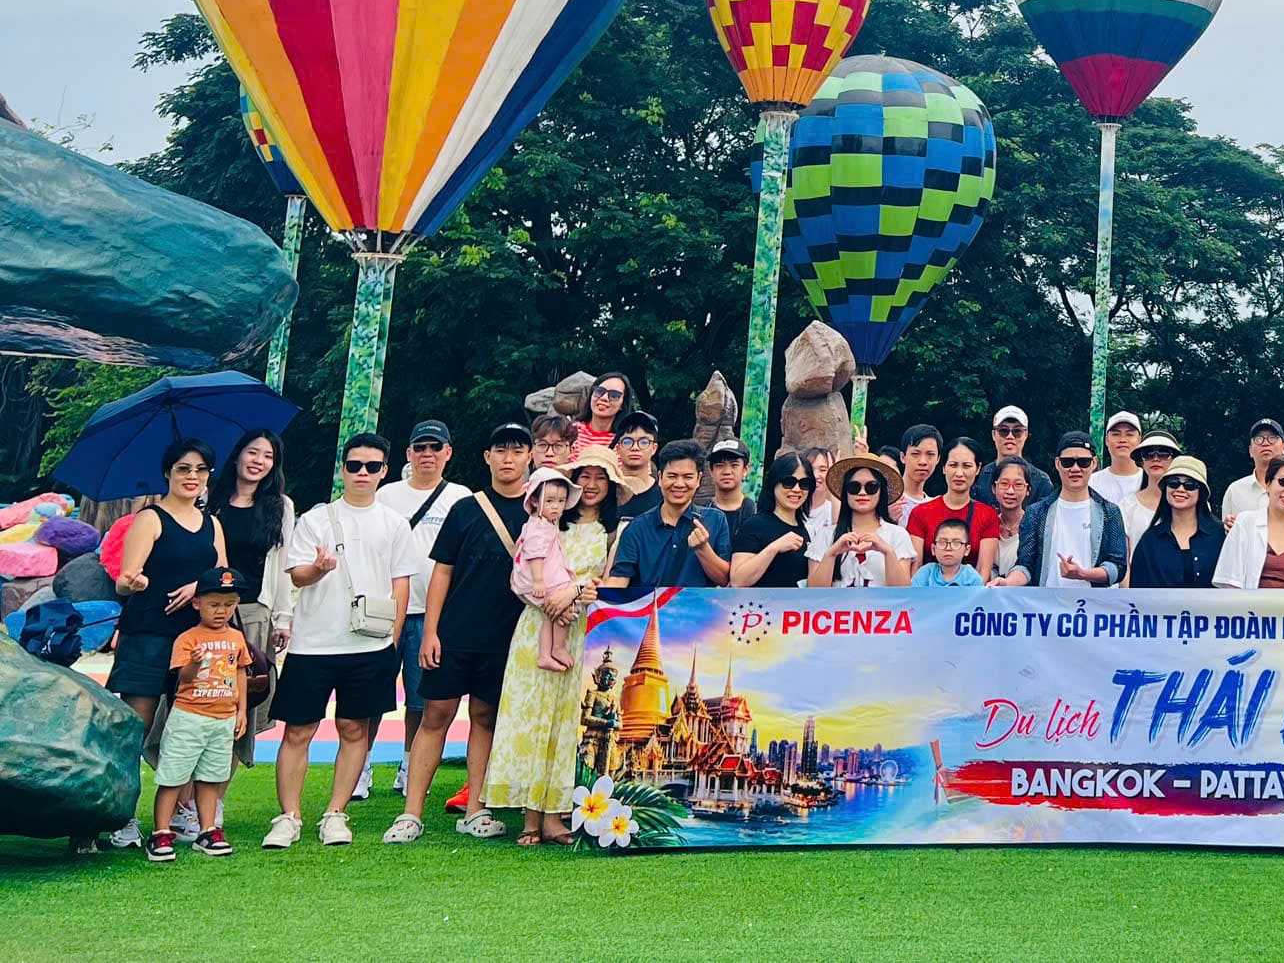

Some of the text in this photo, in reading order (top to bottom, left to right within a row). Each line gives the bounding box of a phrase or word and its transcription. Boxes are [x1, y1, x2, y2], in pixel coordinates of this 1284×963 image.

[782, 610, 913, 635] PICENZA
[954, 606, 1018, 637] CÔNG
[1022, 613, 1053, 637] TY
[1056, 599, 1089, 638] CỔ
[1093, 602, 1158, 638] PHẦN
[1162, 610, 1209, 645] TẬP
[1213, 611, 1277, 640] ĐOÀN
[974, 698, 1037, 749] Du
[1044, 698, 1101, 747] lịch
[1109, 649, 1276, 750] THÁI
[1009, 767, 1168, 799] BANGKOK
